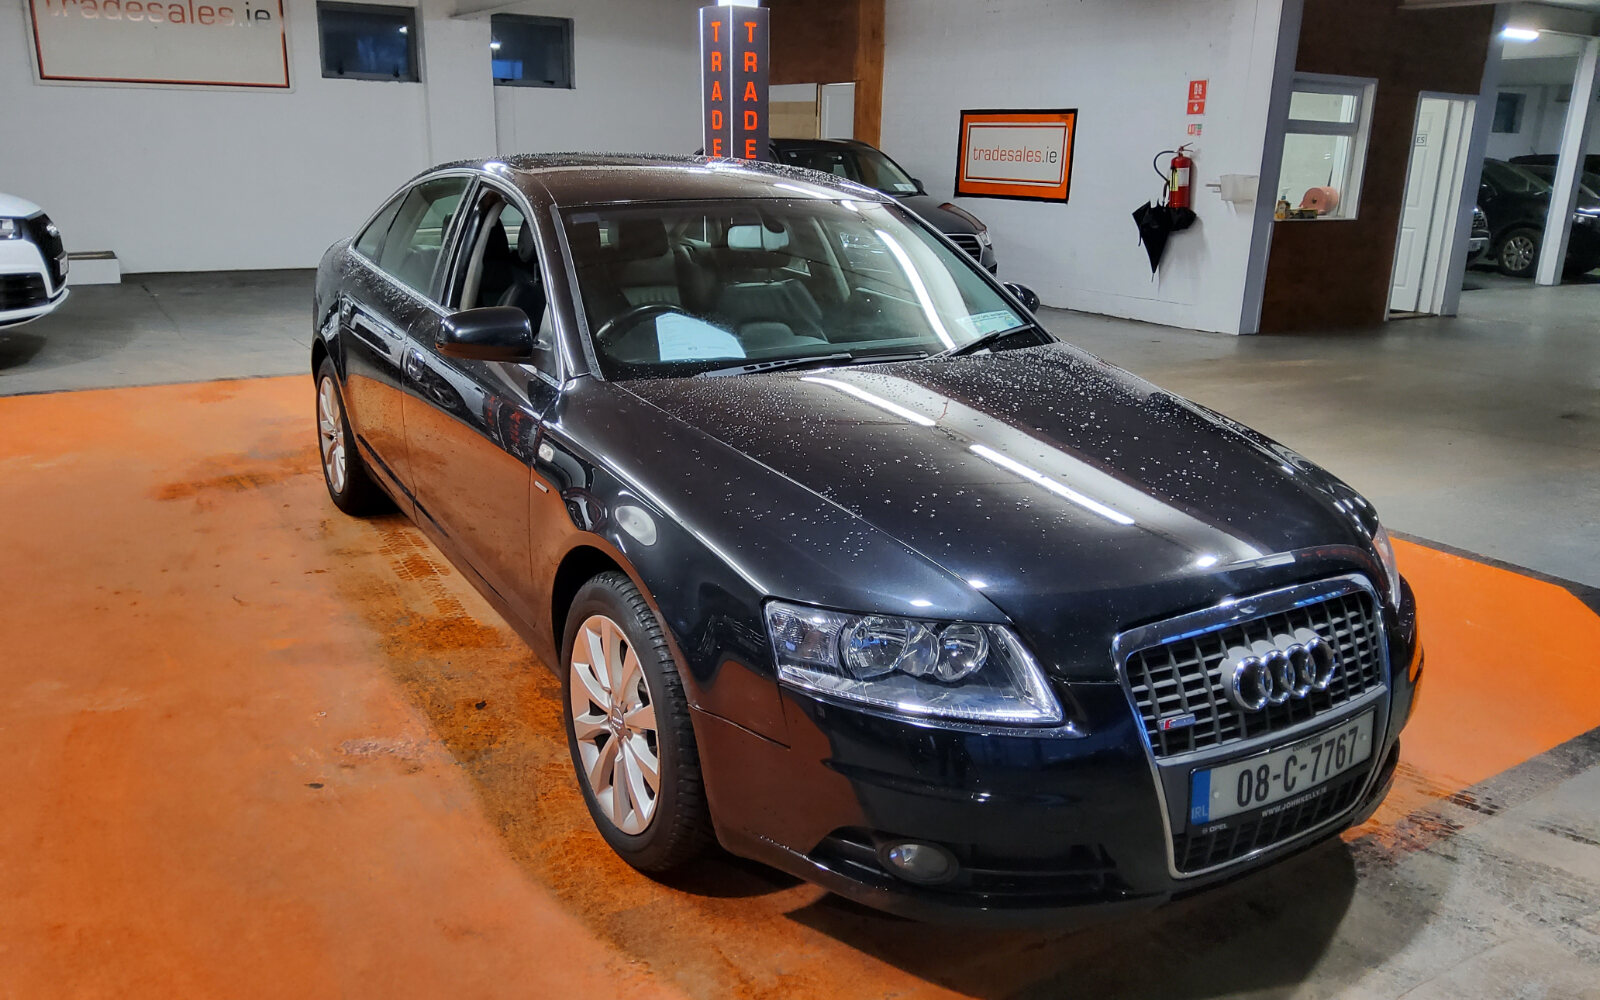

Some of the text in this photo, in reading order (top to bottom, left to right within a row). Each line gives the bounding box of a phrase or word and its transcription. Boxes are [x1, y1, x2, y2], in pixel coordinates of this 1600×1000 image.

[711, 21, 723, 157] TRADE
[744, 21, 758, 159] TRADE
[973, 145, 1057, 164] tradesales.ie
[1237, 726, 1359, 808] 08-C-7767
[1191, 805, 1209, 820] IRL
